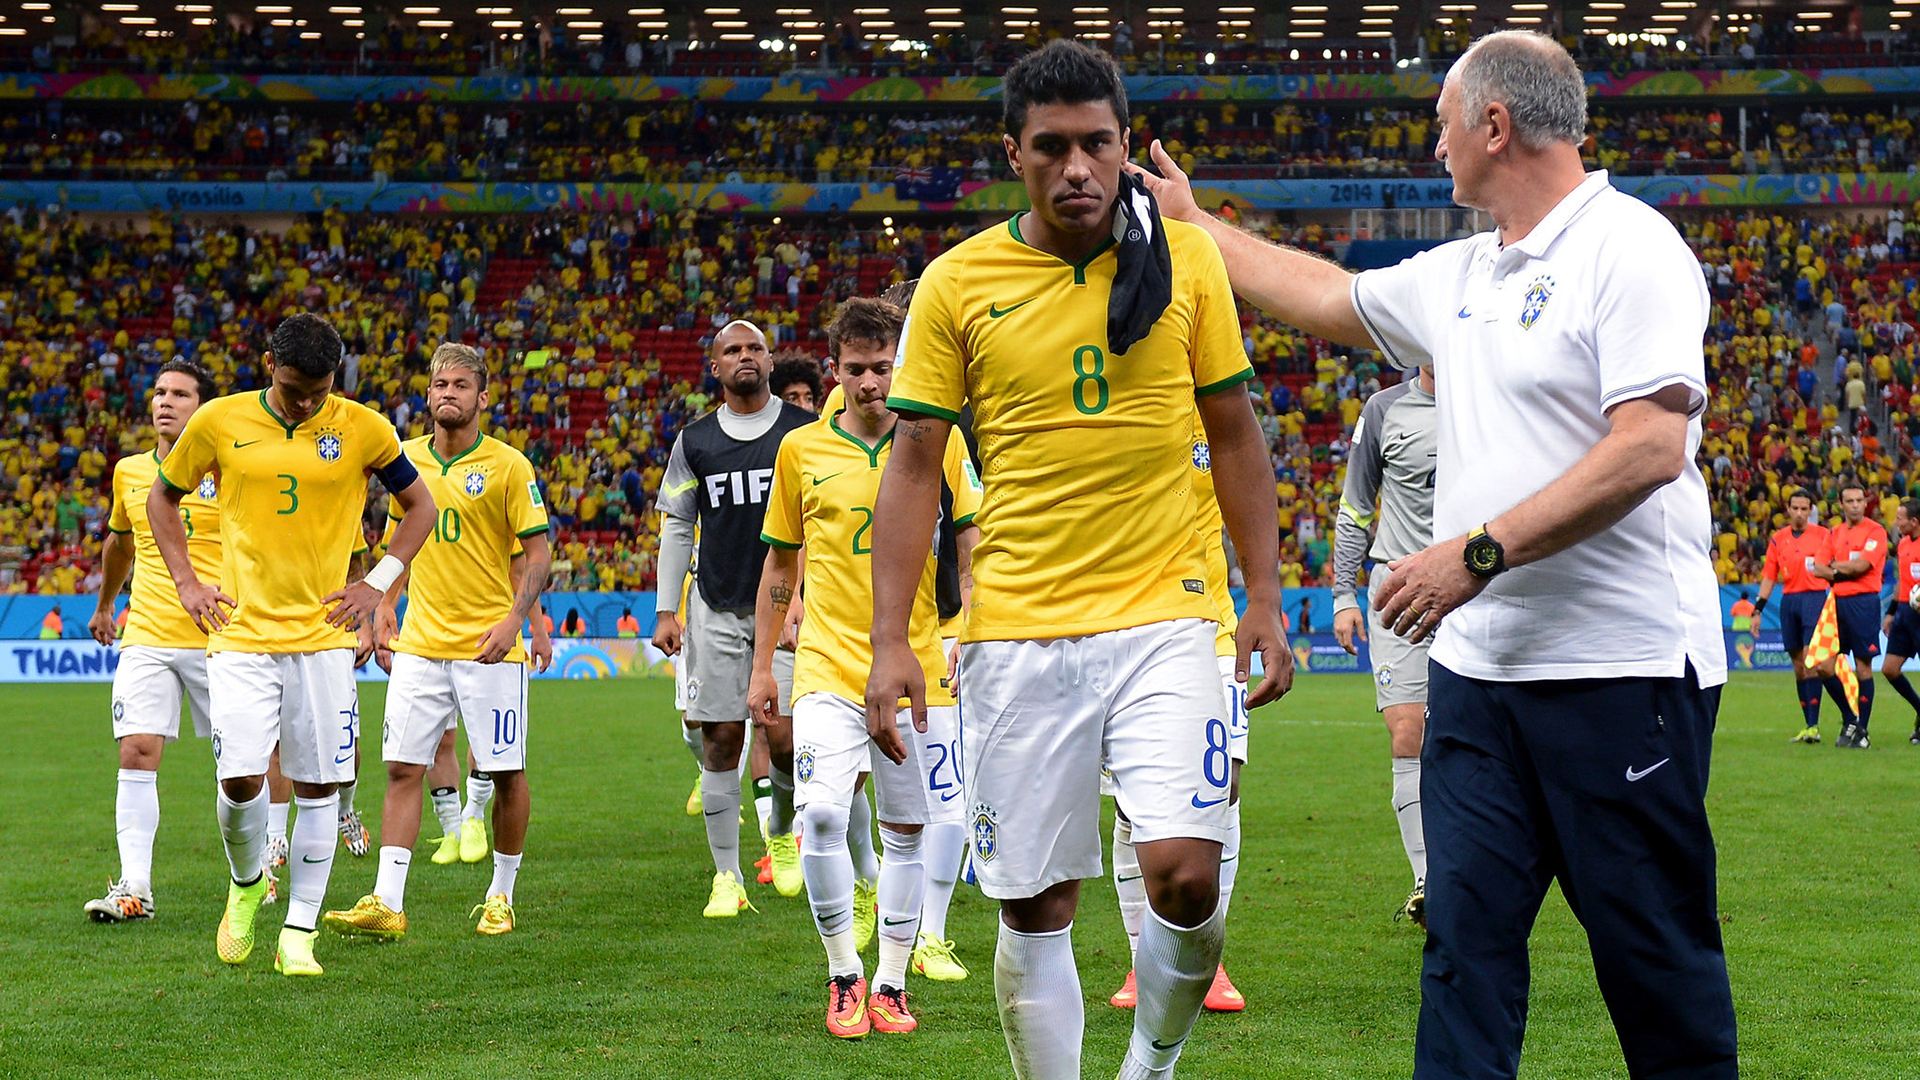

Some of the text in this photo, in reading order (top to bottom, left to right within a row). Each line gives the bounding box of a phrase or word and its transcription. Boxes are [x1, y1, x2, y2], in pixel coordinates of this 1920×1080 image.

[1329, 183, 1373, 203] 2014
[1072, 344, 1109, 415] 8
[277, 473, 299, 515] 3
[434, 507, 461, 543] 10
[339, 710, 354, 750] 3
[491, 708, 517, 745] 10
[1203, 718, 1230, 789] 8
